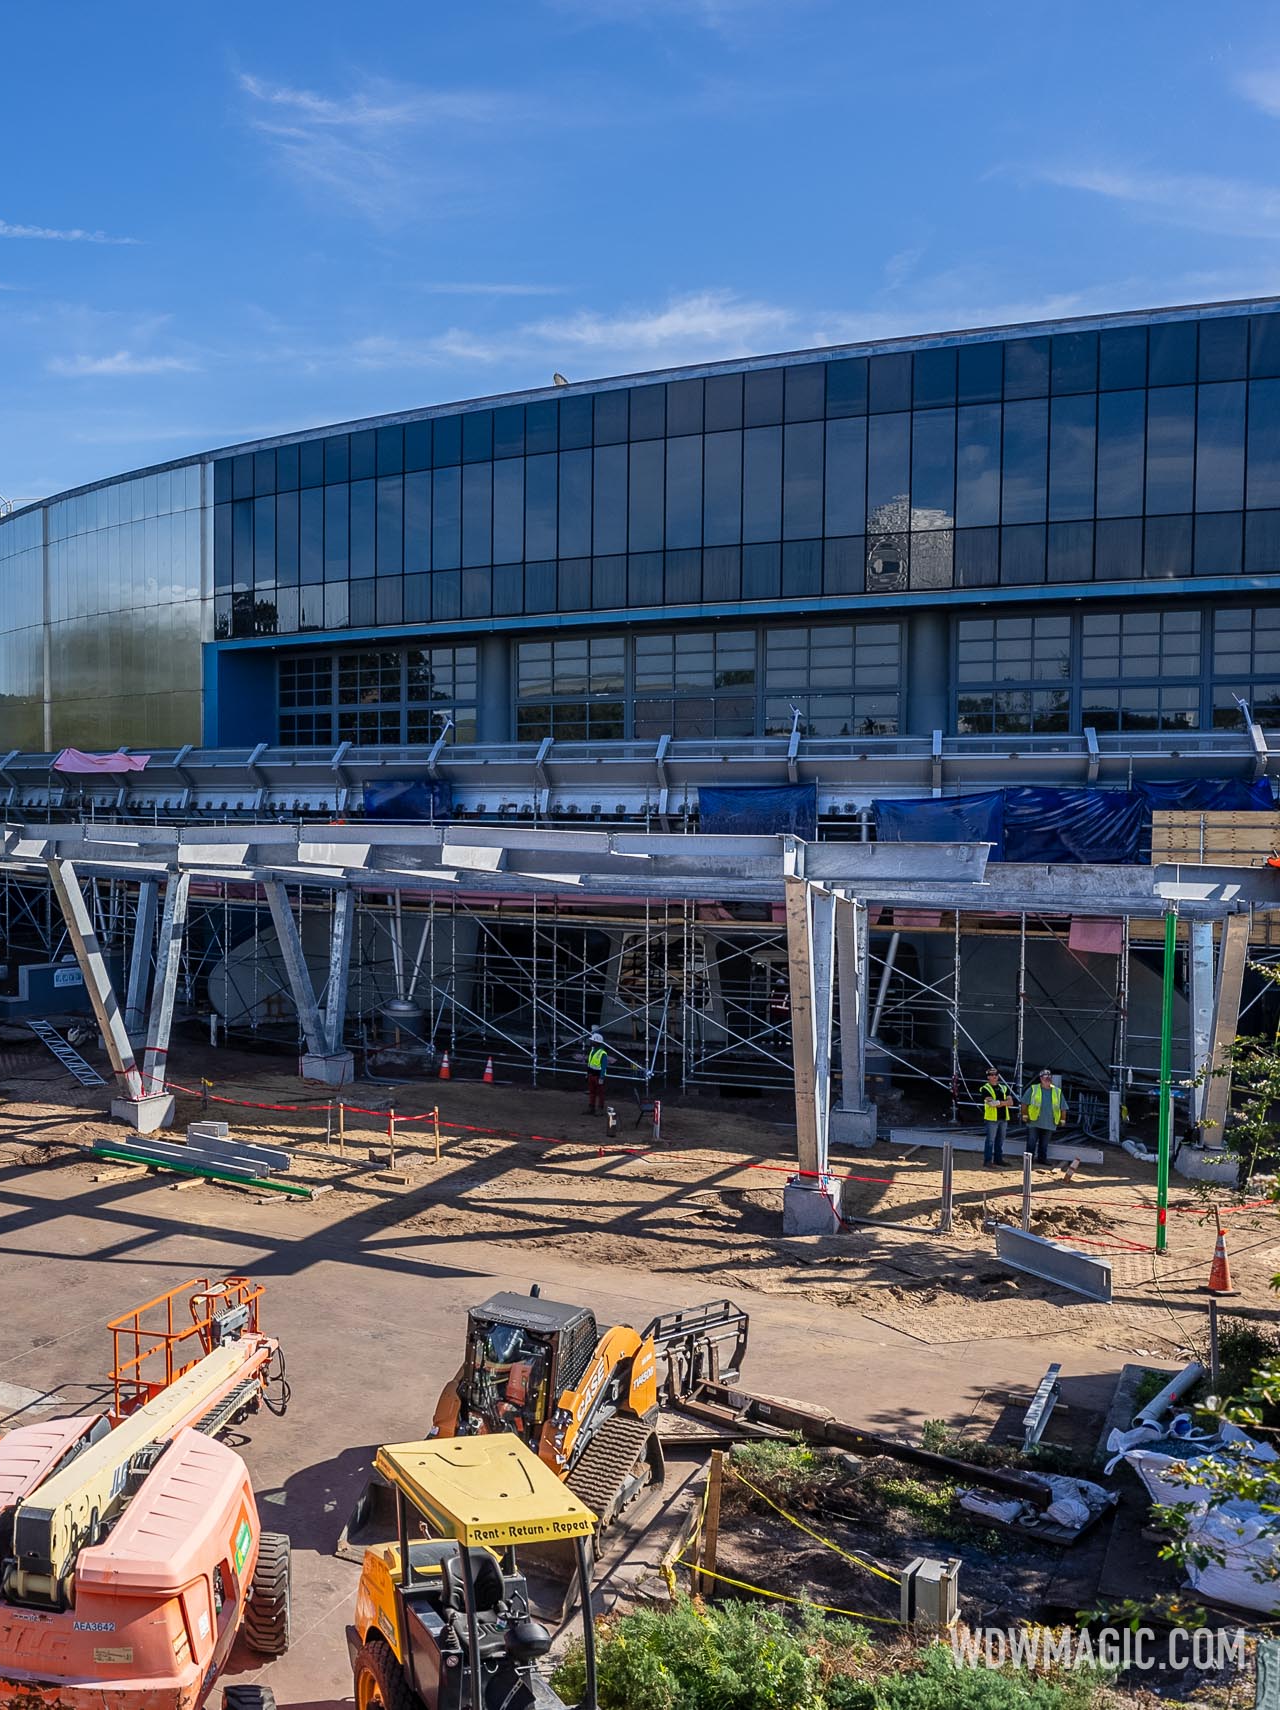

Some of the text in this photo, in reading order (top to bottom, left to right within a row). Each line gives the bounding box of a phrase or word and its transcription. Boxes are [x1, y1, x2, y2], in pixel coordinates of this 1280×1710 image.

[577, 1362, 605, 1422] CASE
[474, 1519, 590, 1541] Rent Return Repeat
[74, 1622, 115, 1632] AEA3642
